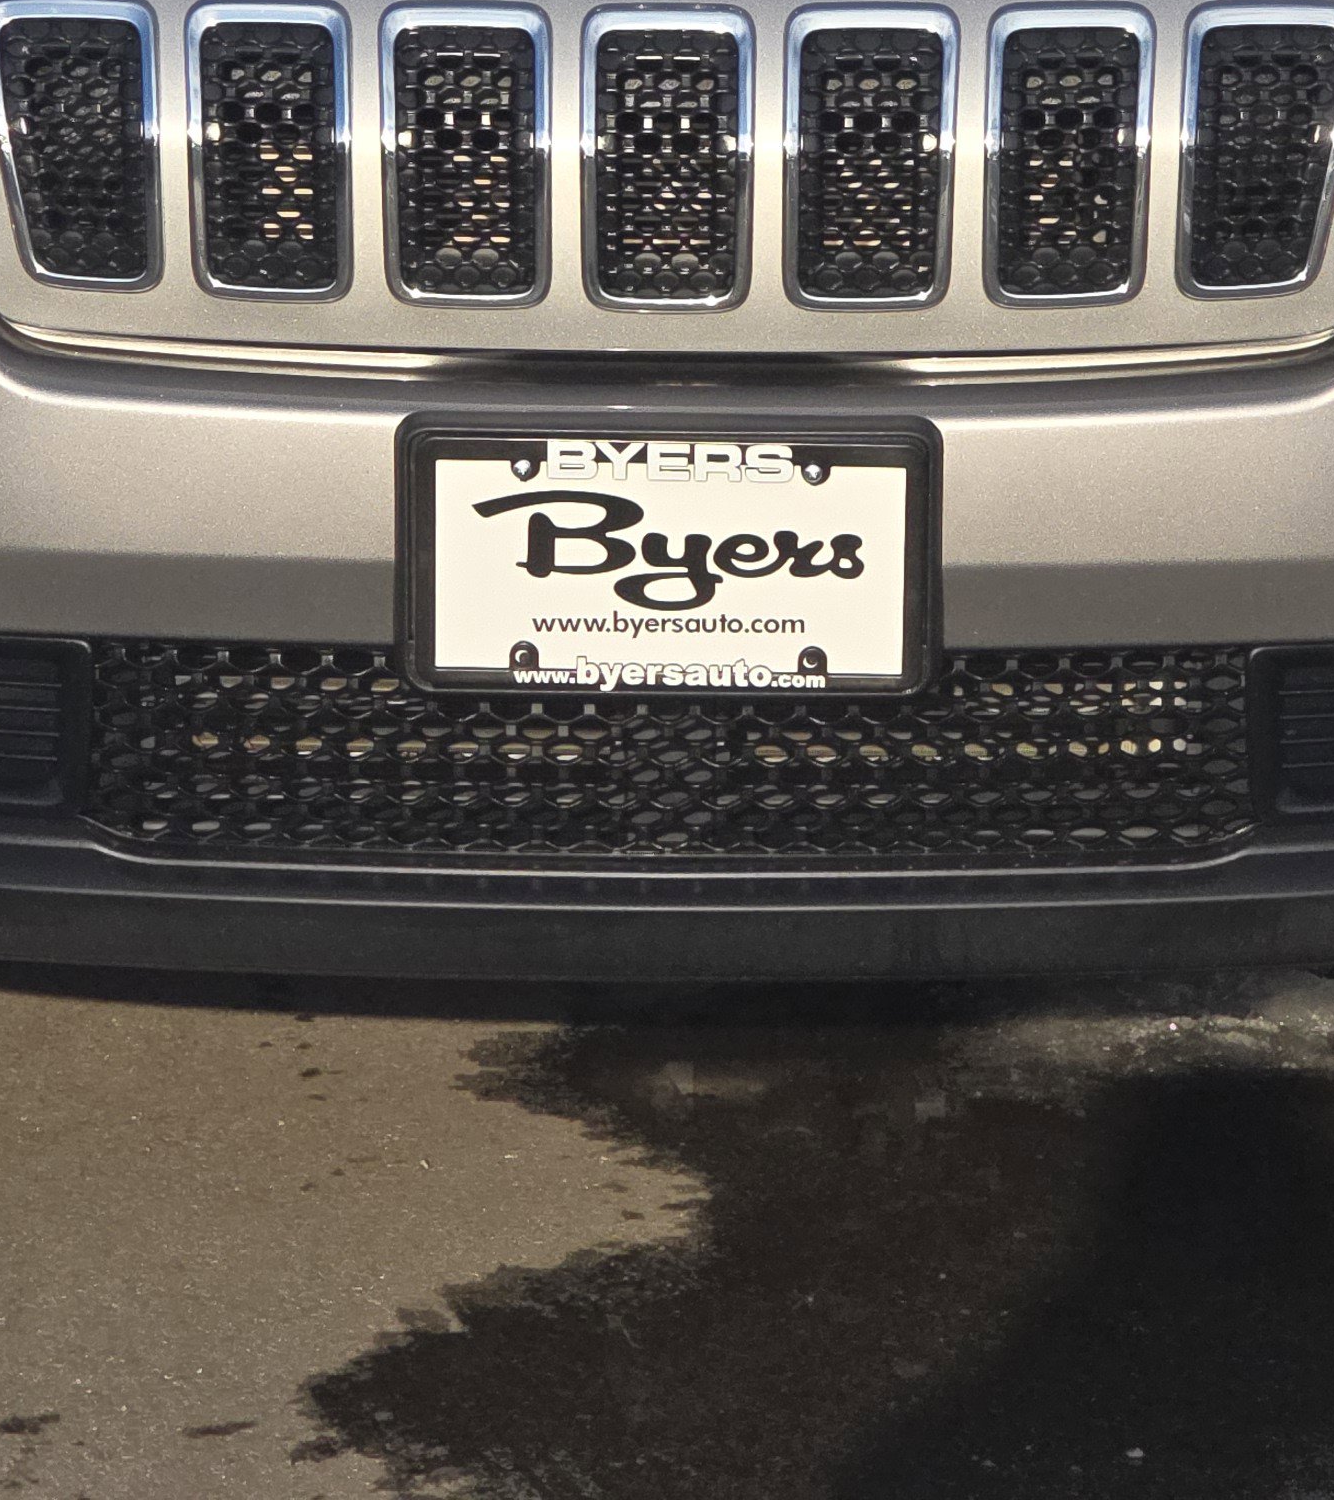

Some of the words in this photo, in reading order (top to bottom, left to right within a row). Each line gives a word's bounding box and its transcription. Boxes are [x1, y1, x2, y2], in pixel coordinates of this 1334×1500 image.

[546, 439, 794, 483] BYERS
[471, 490, 865, 611] Byers
[531, 610, 806, 639] www.byersauto.com
[512, 655, 826, 692] www.byersauto.com
